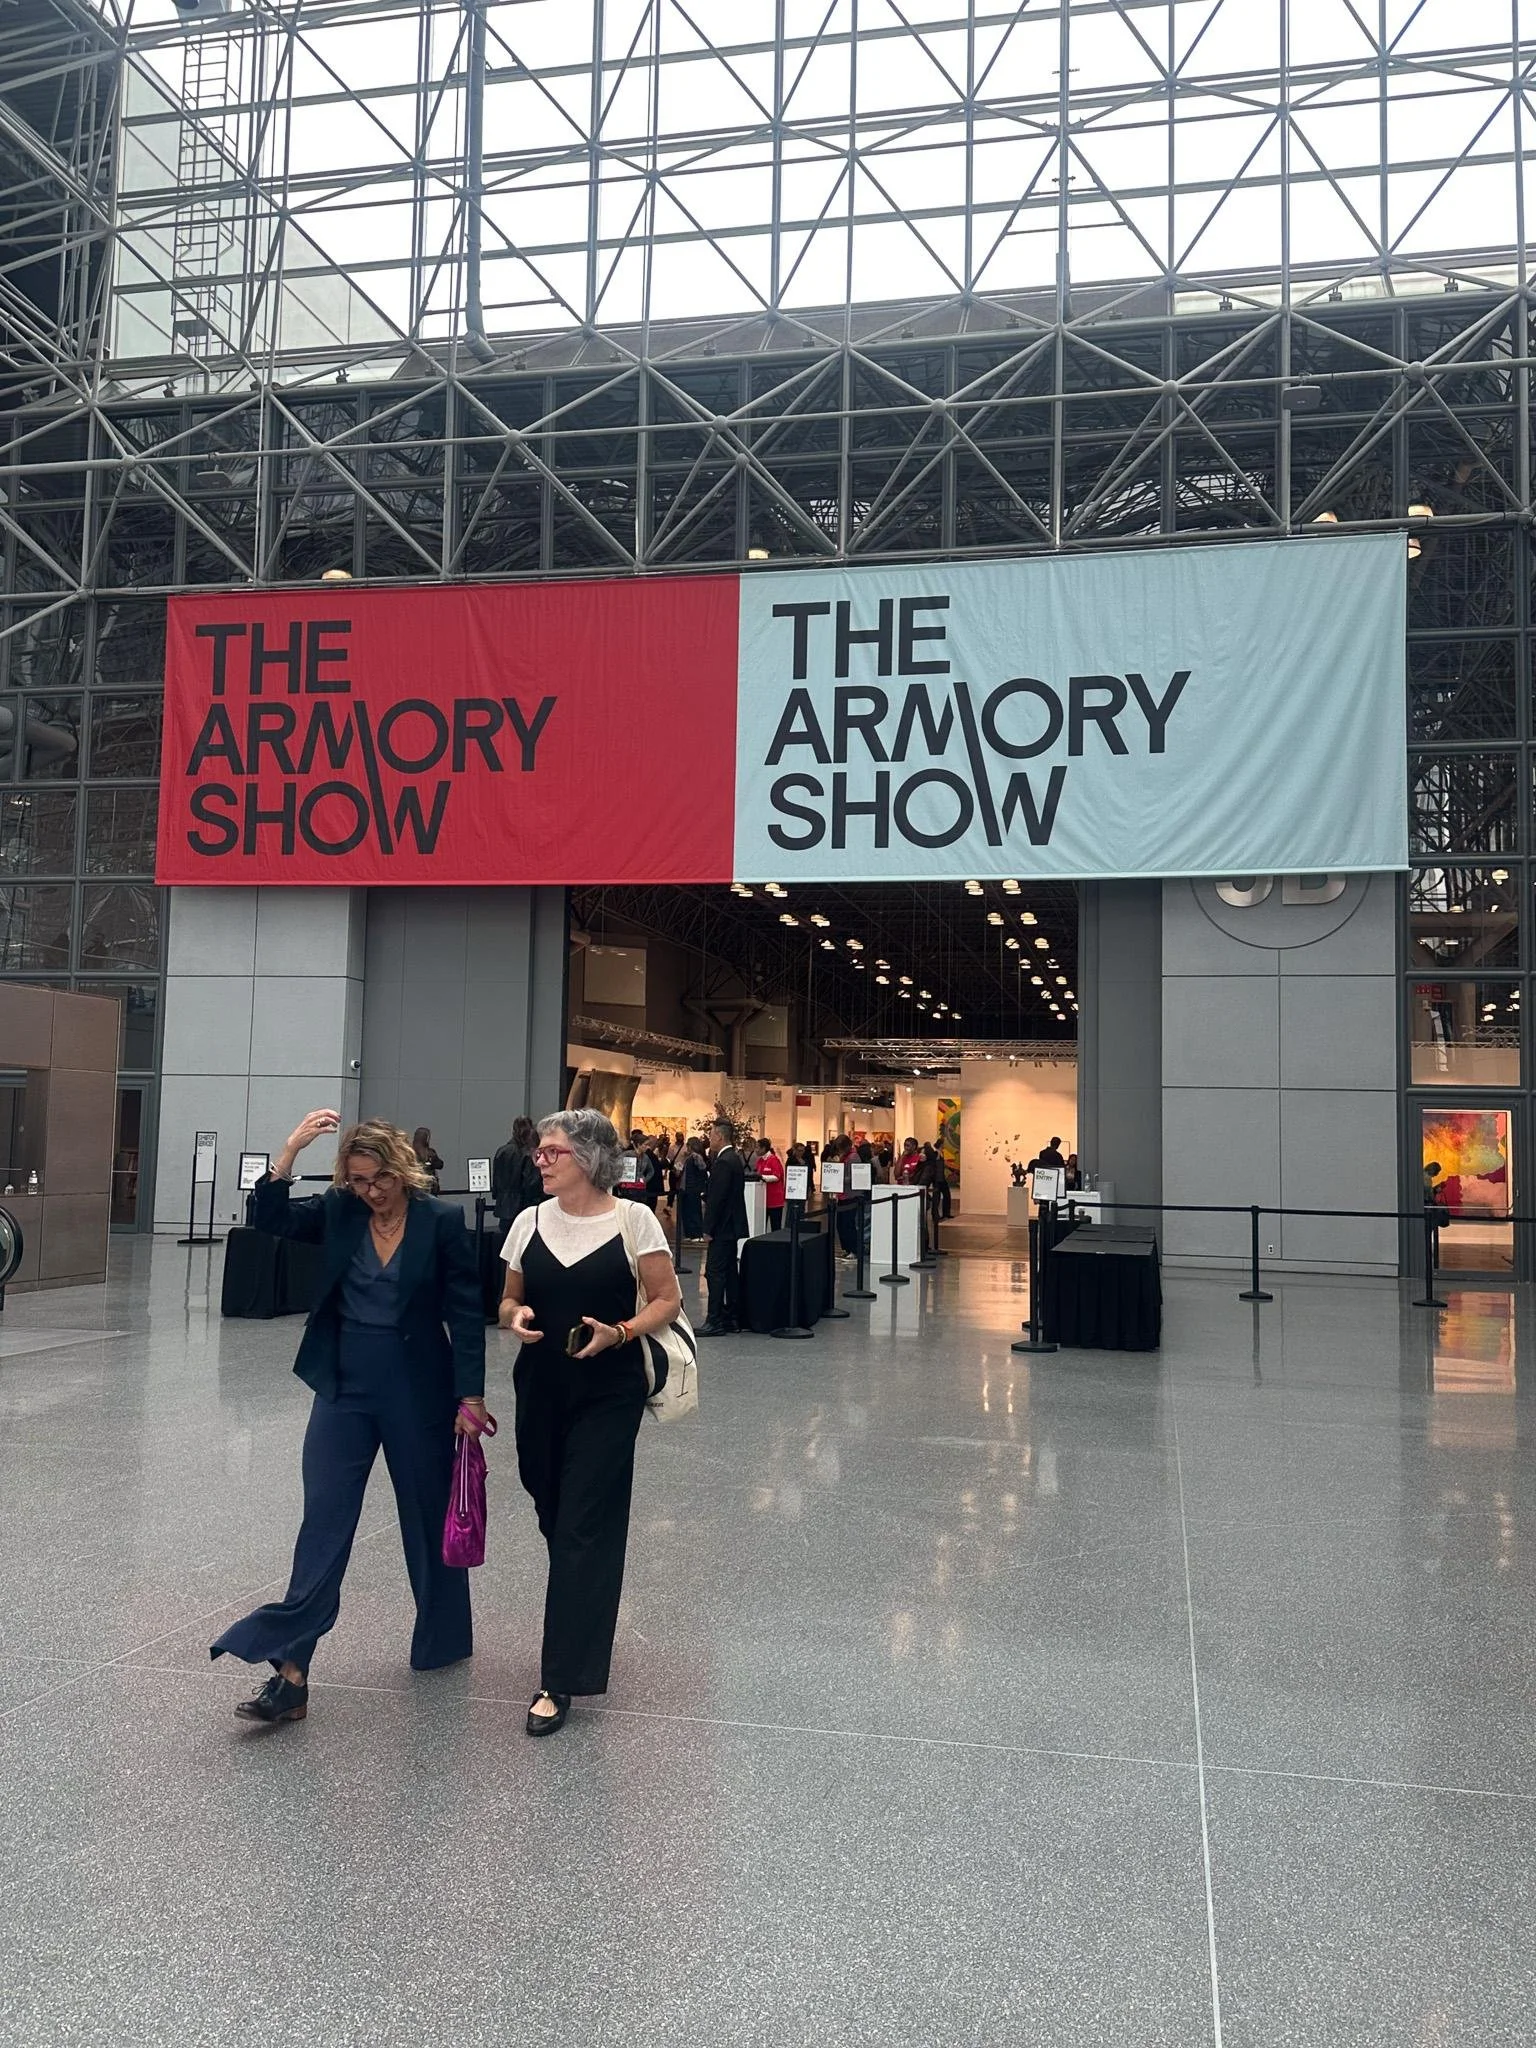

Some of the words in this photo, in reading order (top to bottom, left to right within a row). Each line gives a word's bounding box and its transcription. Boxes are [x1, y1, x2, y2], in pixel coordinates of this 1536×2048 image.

[195, 619, 352, 697] THE
[772, 595, 951, 680] THE
[185, 697, 558, 777] ARMORY
[763, 670, 1192, 766] ARMORY
[187, 780, 452, 857] SHOW
[767, 765, 1068, 851] SHOW
